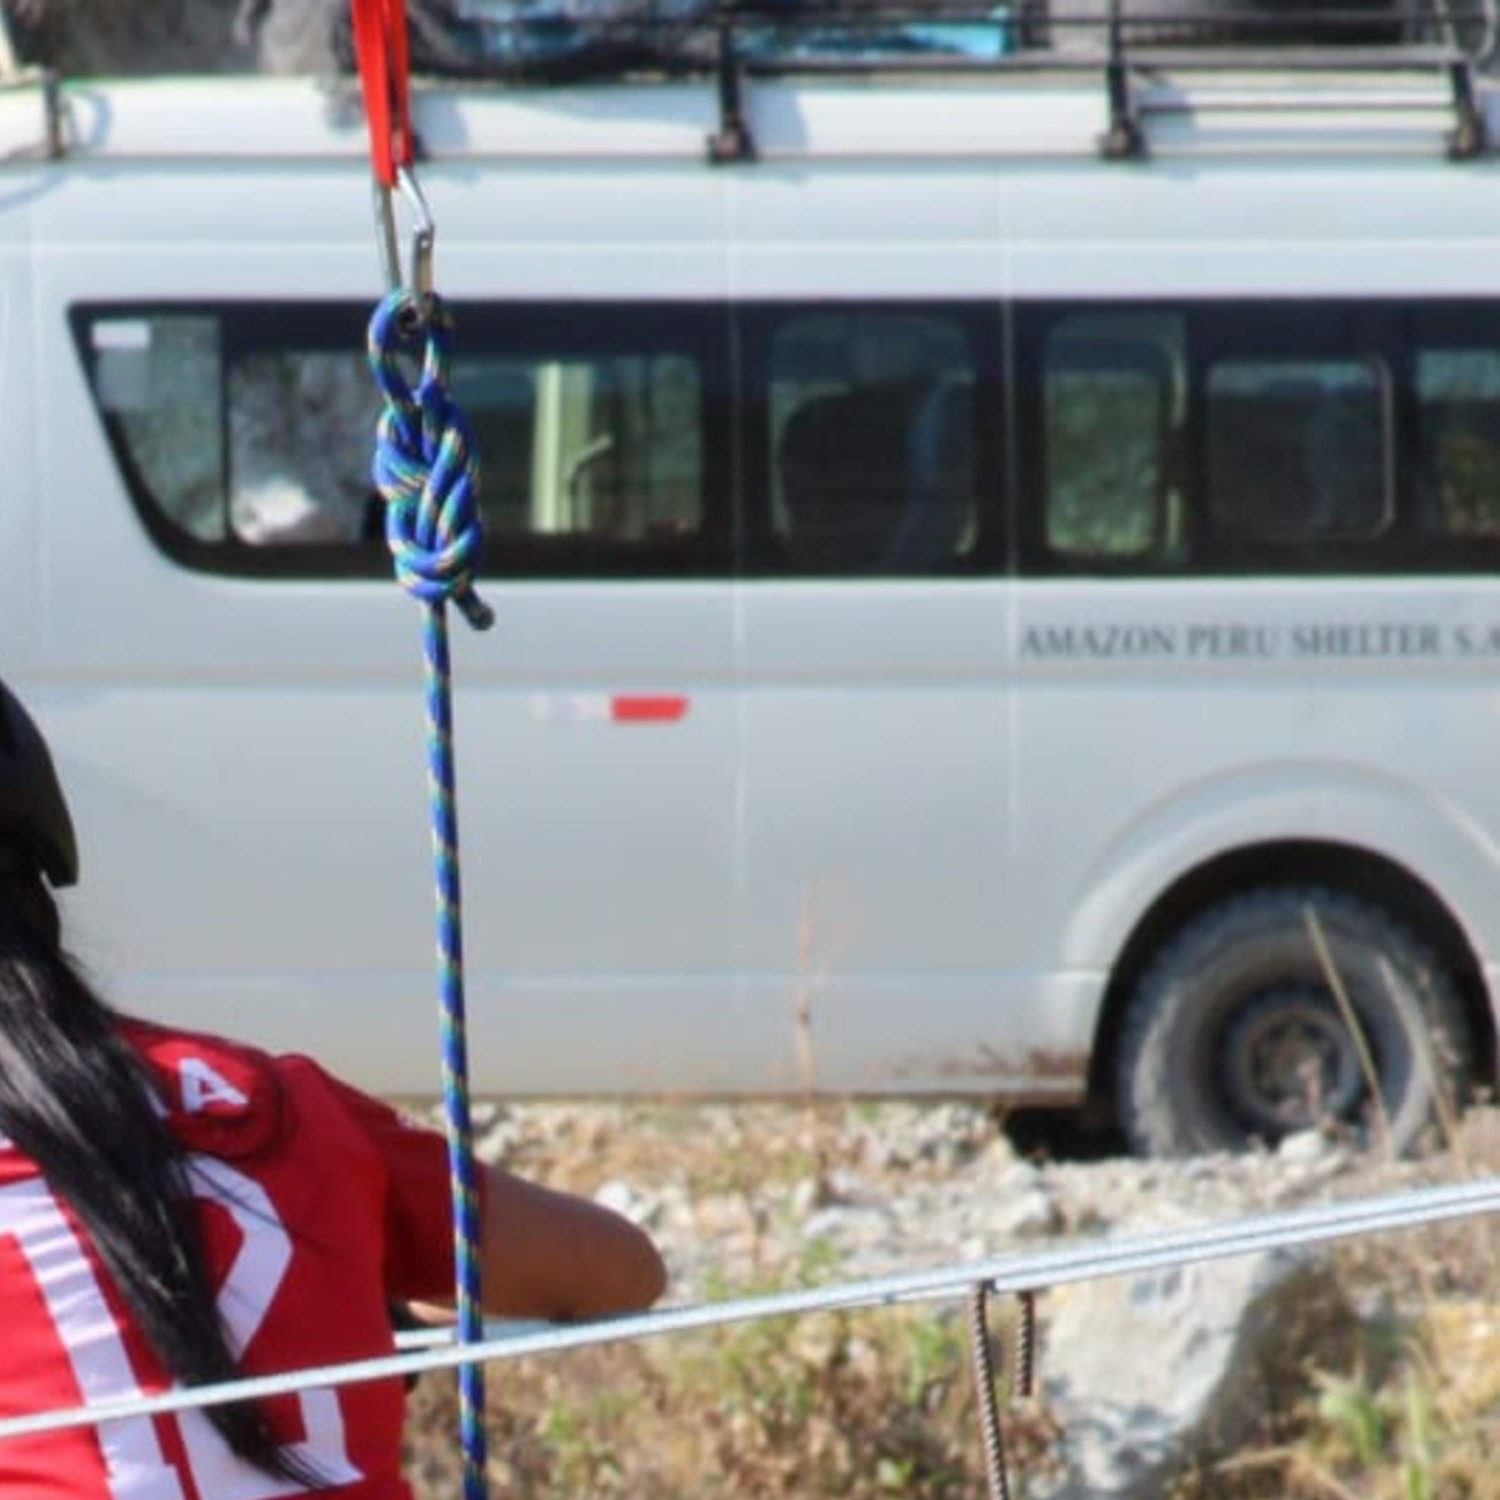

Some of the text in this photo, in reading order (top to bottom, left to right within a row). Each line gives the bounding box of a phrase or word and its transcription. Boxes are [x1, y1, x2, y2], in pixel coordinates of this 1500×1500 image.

[1020, 624, 1177, 657] AMAZON
[1187, 624, 1279, 657] PERU
[1290, 624, 1442, 657] SHELTER
